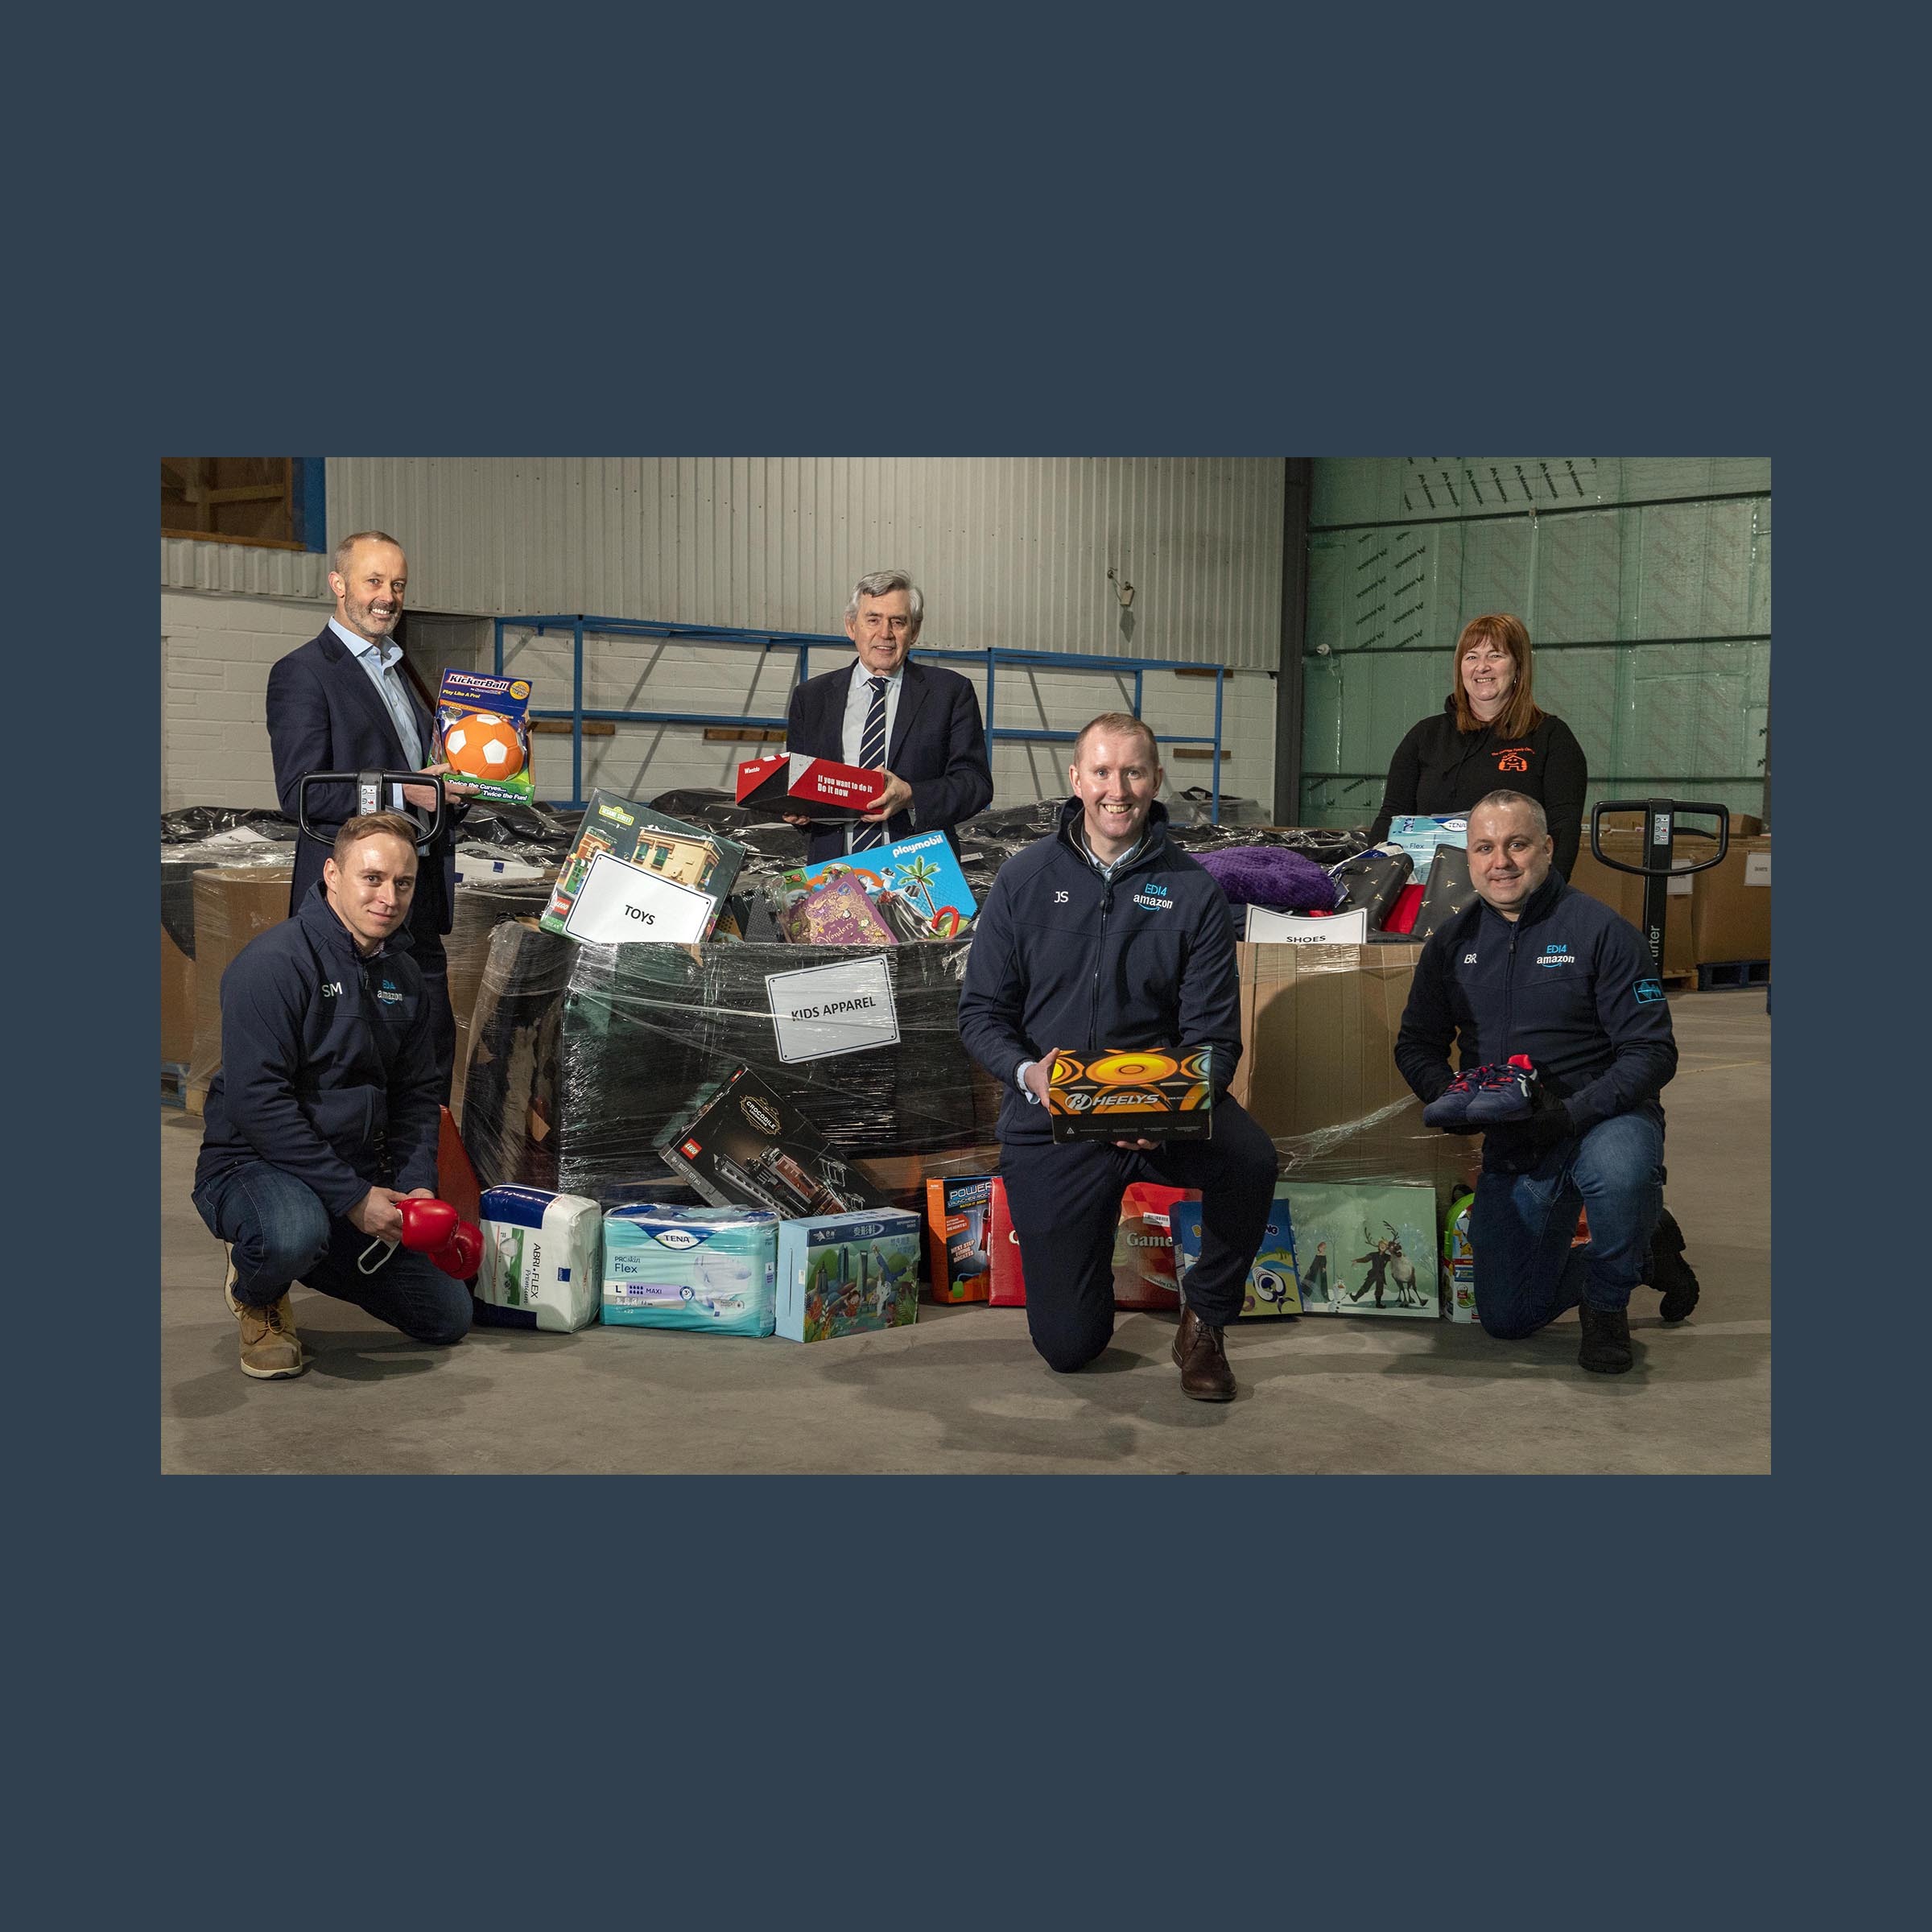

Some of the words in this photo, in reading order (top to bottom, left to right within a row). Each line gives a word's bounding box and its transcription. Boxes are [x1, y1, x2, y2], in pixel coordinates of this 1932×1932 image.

[449, 675, 508, 690] KickerBall
[448, 779, 468, 787] Twice
[469, 781, 479, 789] the
[817, 783, 827, 792] Do
[828, 785, 833, 794] it
[834, 789, 848, 797] now
[818, 774, 823, 782] If
[824, 777, 835, 785] you
[836, 778, 850, 788] want
[852, 782, 858, 790] to
[859, 783, 866, 791] do
[867, 785, 873, 793] it
[483, 790, 502, 798] Twice
[893, 834, 943, 858] playmobil
[1054, 891, 1069, 903] JS
[1145, 883, 1167, 897] EDI4
[1133, 894, 1173, 909] amazon
[625, 904, 655, 925] TOYS
[816, 921, 854, 943] Wonders
[1286, 935, 1327, 943] SHOES
[1464, 953, 1477, 964] BR
[1537, 955, 1575, 964] amazon
[322, 982, 343, 997] SM
[378, 990, 402, 1001] amazon
[791, 1007, 819, 1022] KIDS
[823, 997, 876, 1016] APPAREL
[1092, 1094, 1159, 1106] HEELYS
[746, 1100, 776, 1129] CROCODILE
[665, 1234, 689, 1243] TENA
[1127, 1232, 1174, 1247] Game
[614, 1263, 638, 1274] Flex
[523, 1269, 531, 1304] Premium
[615, 1285, 622, 1294] L
